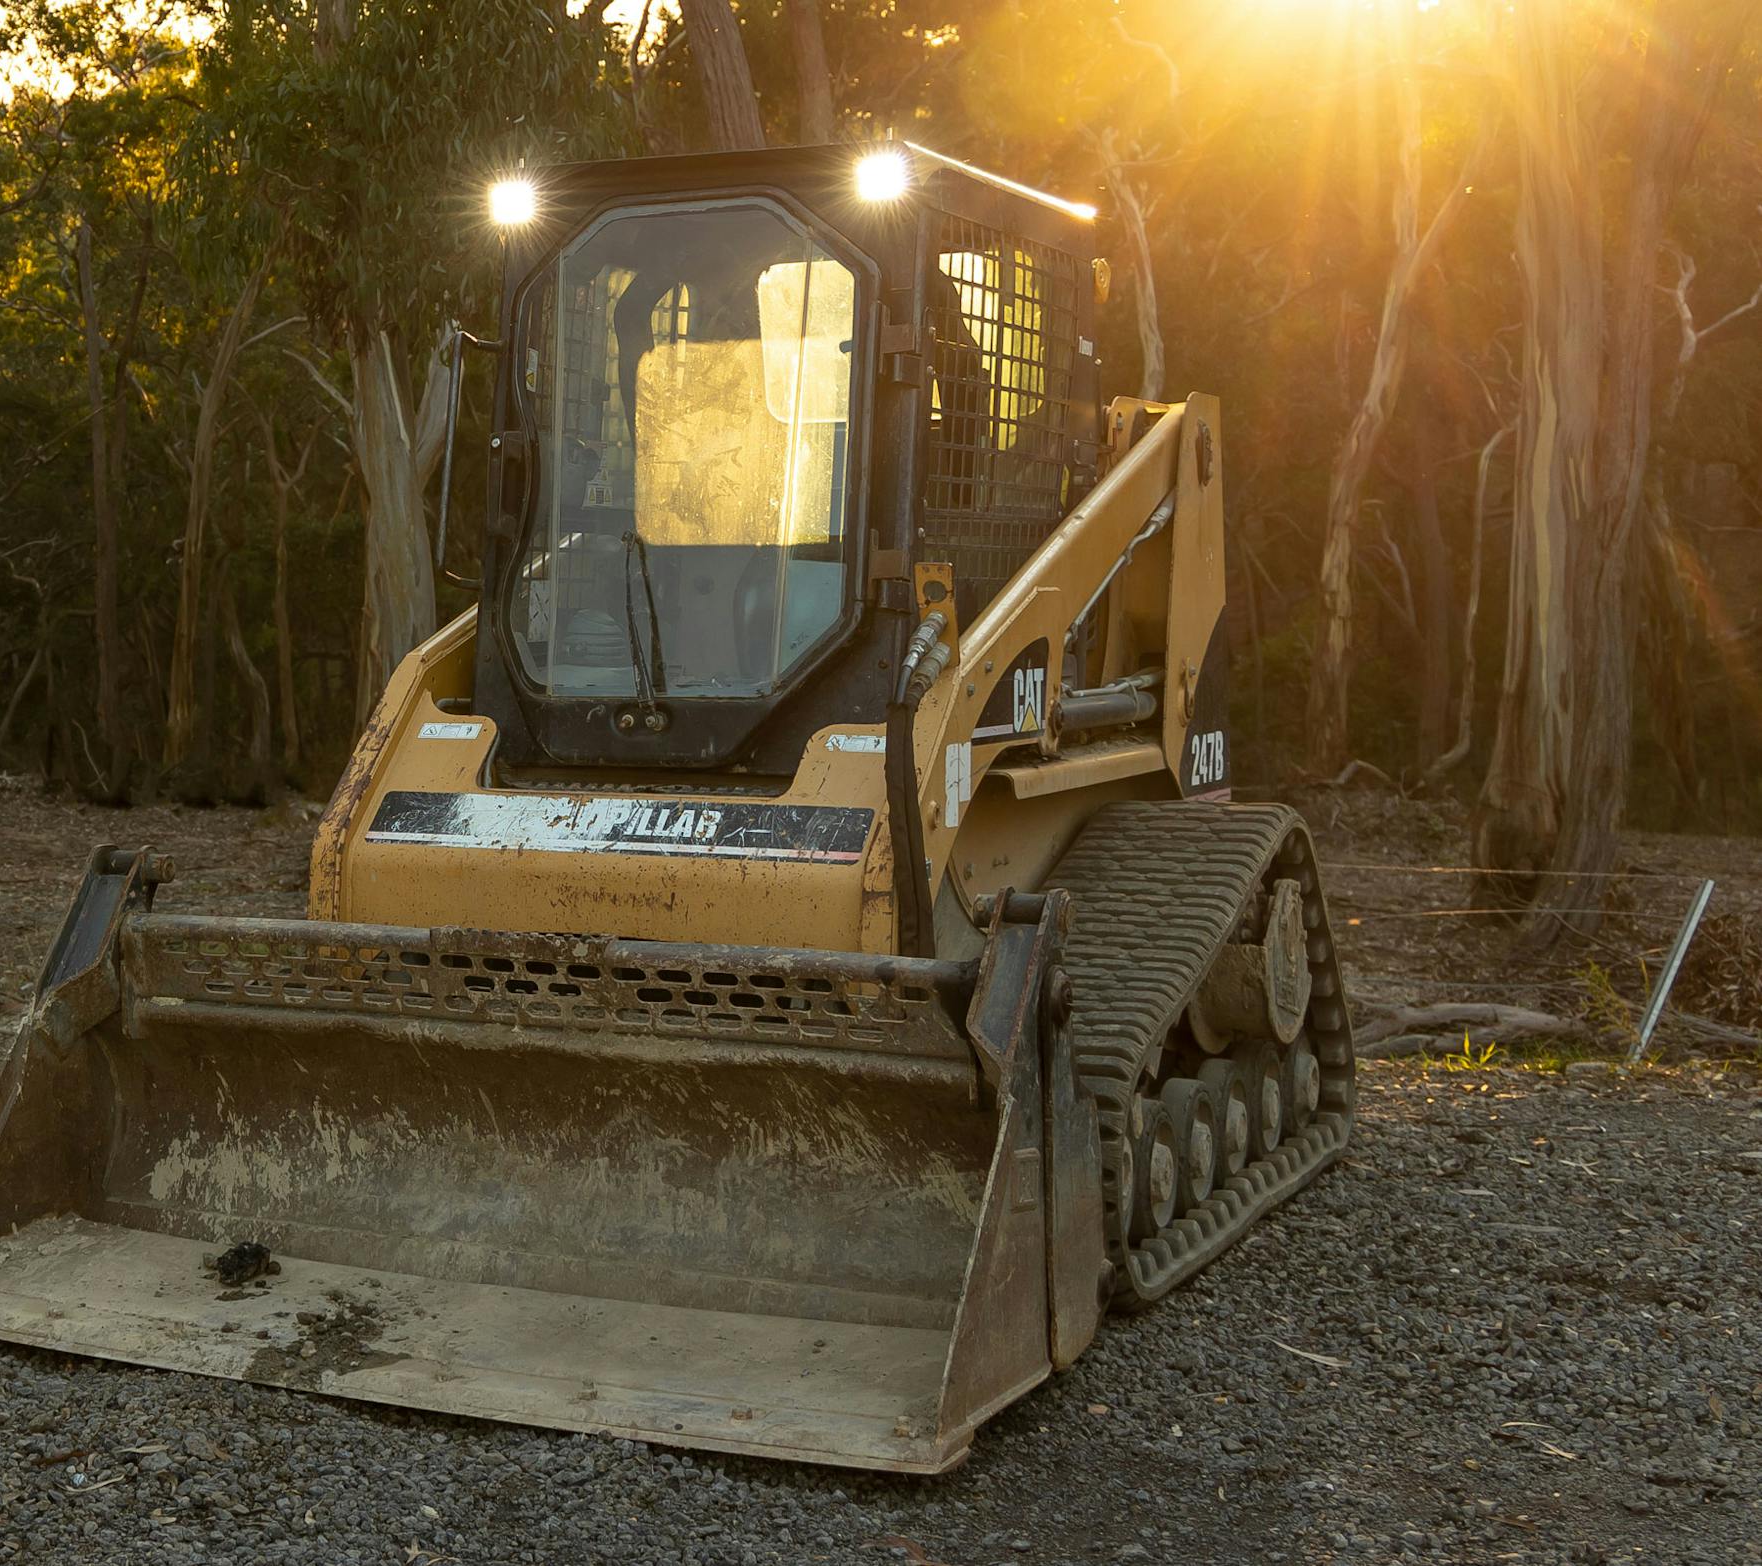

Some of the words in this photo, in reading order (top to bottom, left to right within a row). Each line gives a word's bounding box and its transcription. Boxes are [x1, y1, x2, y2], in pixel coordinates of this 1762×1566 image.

[1013, 668, 1044, 733] CAT
[1191, 731, 1224, 785] 247B
[580, 803, 722, 840] PILLAR
